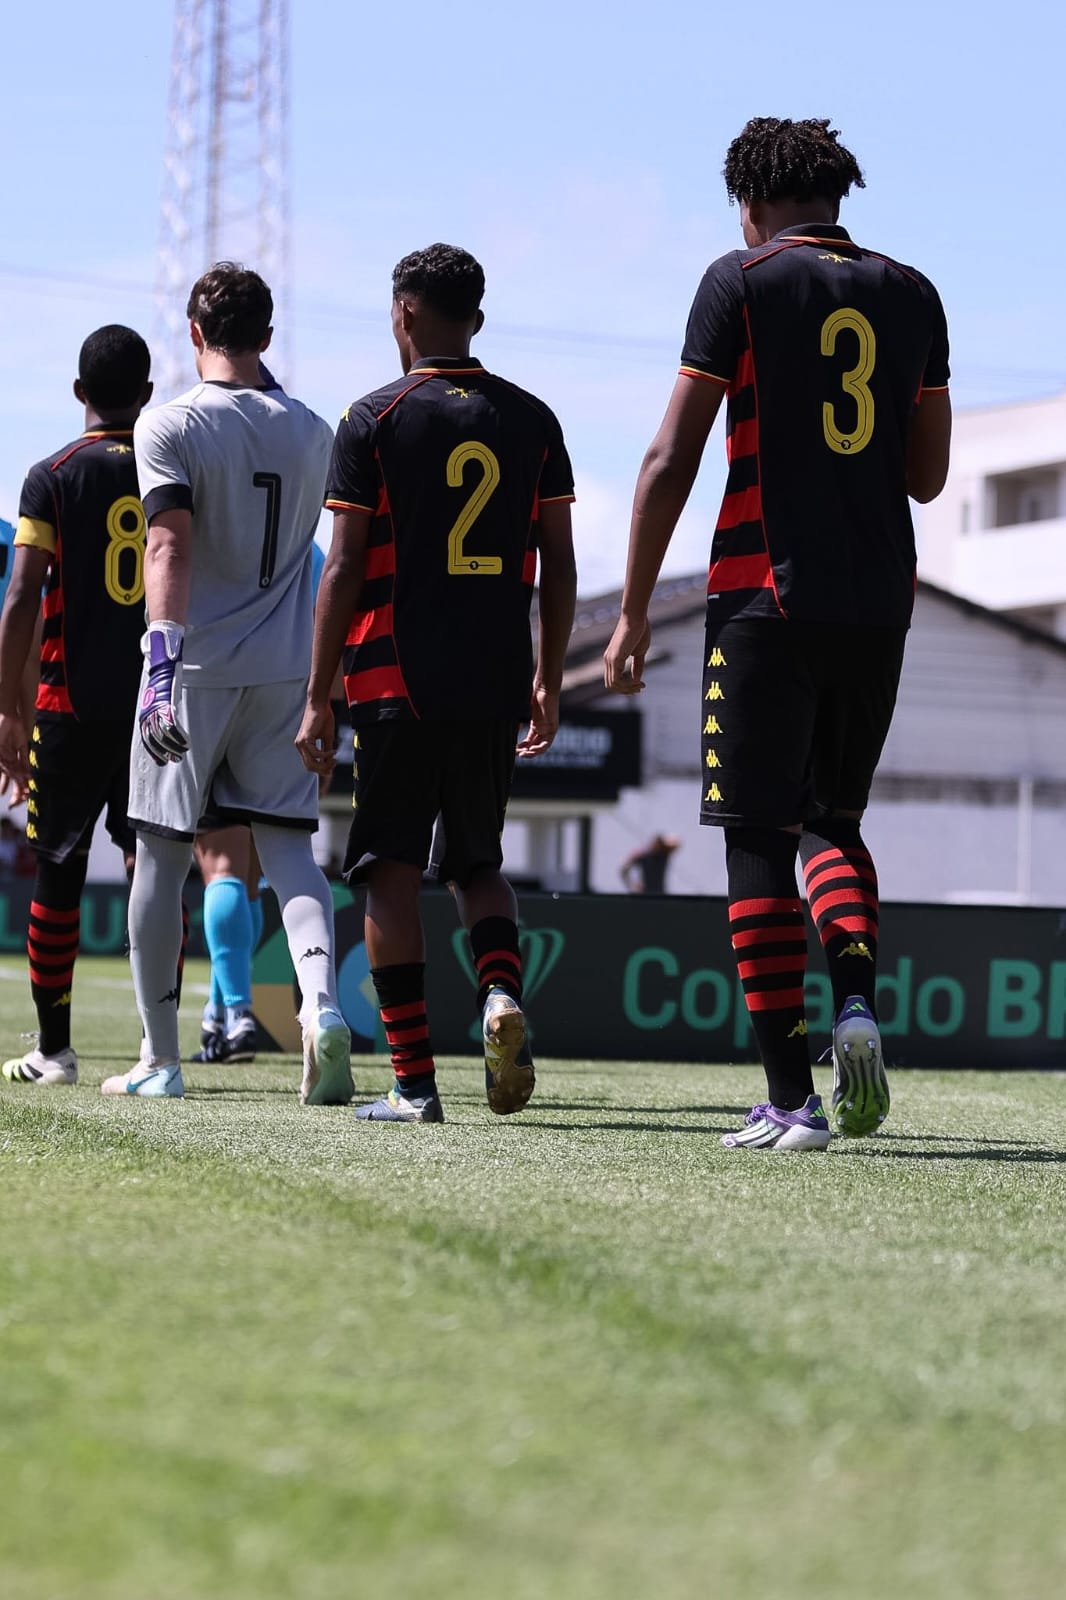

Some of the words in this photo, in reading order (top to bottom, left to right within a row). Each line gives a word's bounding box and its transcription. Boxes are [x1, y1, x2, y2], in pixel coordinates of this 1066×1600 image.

[820, 307, 877, 455] 3
[105, 495, 147, 606] 8
[253, 472, 282, 588] 1
[446, 441, 503, 576] 2
[875, 956, 965, 1038] do
